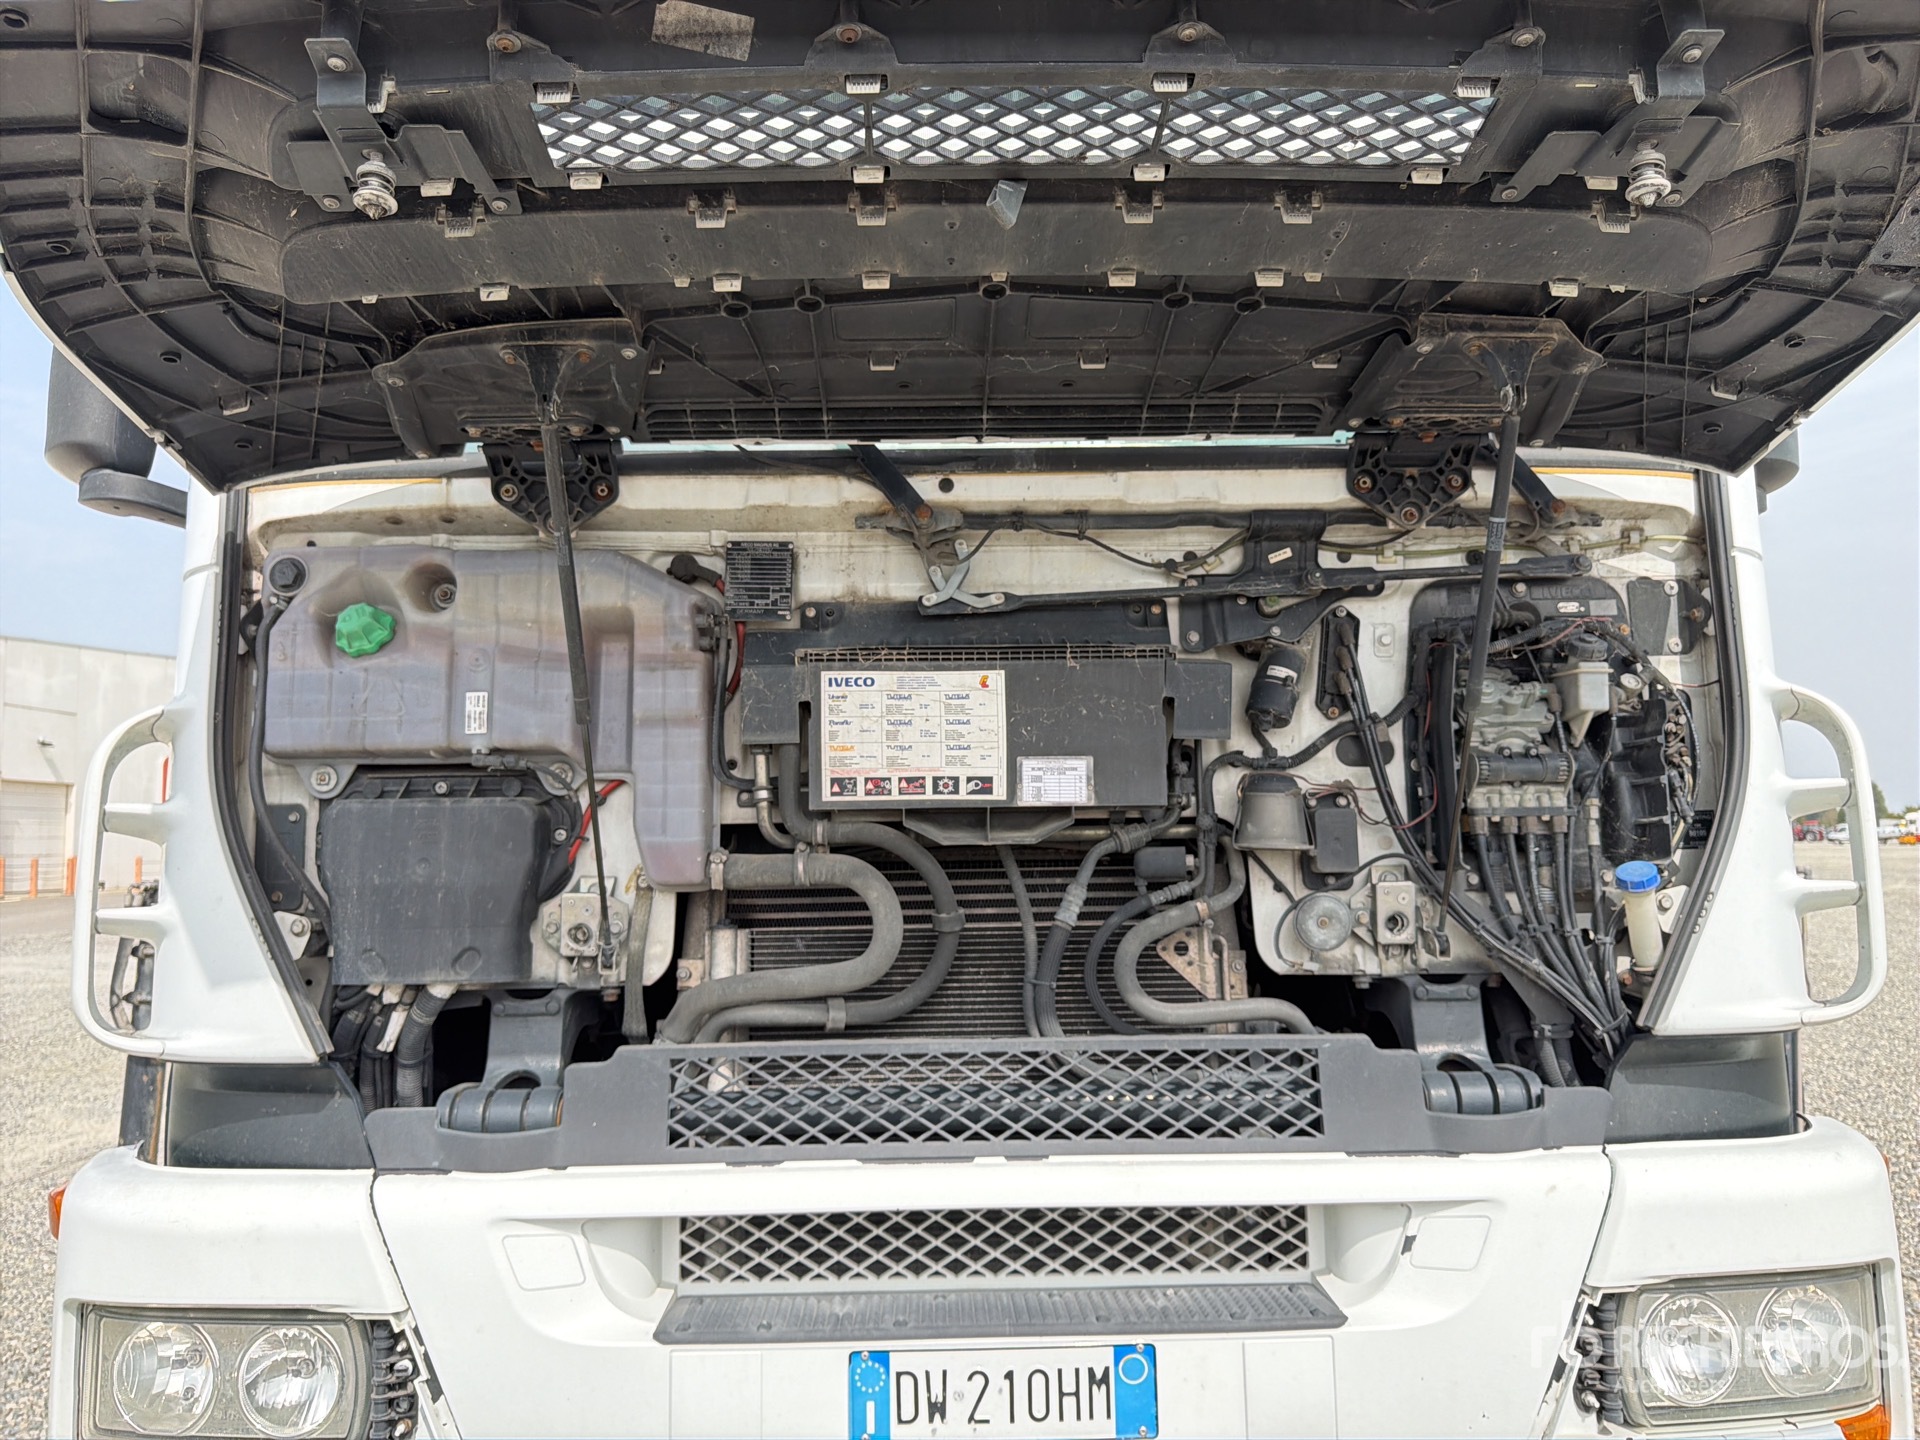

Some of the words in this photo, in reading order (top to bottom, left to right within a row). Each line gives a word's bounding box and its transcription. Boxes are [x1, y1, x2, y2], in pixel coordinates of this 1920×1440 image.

[828, 677, 875, 687] IVECO
[896, 1369, 947, 1425] DW
[967, 1365, 1112, 1425] 210HM
